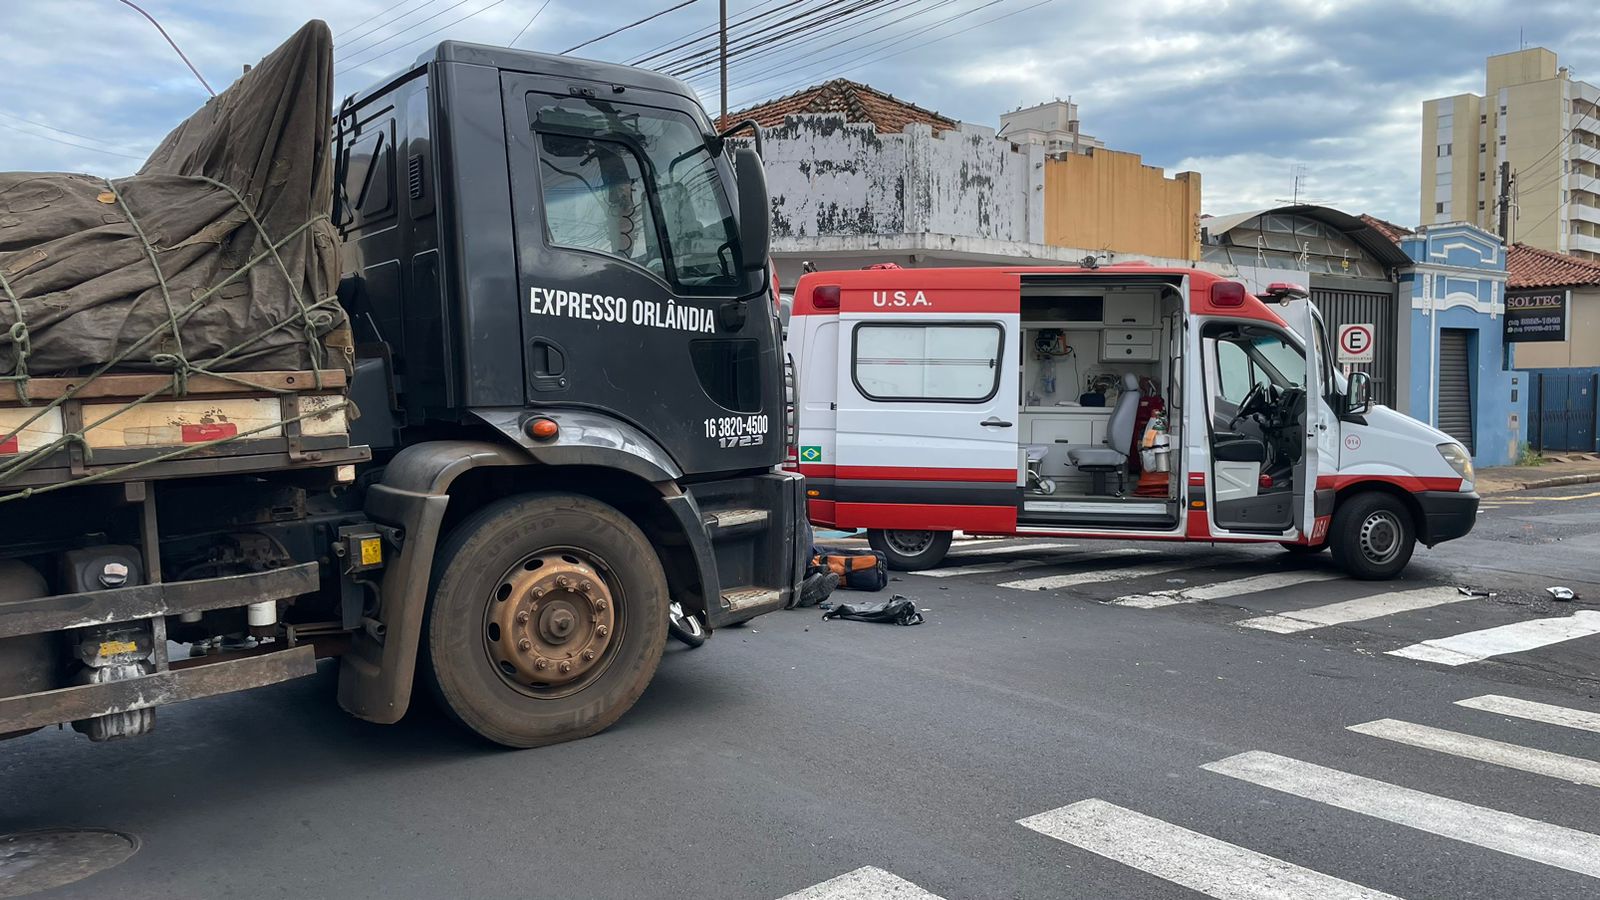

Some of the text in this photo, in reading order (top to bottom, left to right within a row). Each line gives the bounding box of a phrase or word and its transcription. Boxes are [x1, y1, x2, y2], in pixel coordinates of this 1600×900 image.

[873, 291, 932, 307] U.S.A.
[1507, 295, 1561, 307] SOLTEC
[530, 286, 715, 334] EXPRESSO ORLÂNDIA
[1350, 331, 1361, 348] E
[703, 414, 768, 438] 16 3820-4500
[718, 434, 764, 449] 1723
[473, 517, 557, 575] KUMHO
